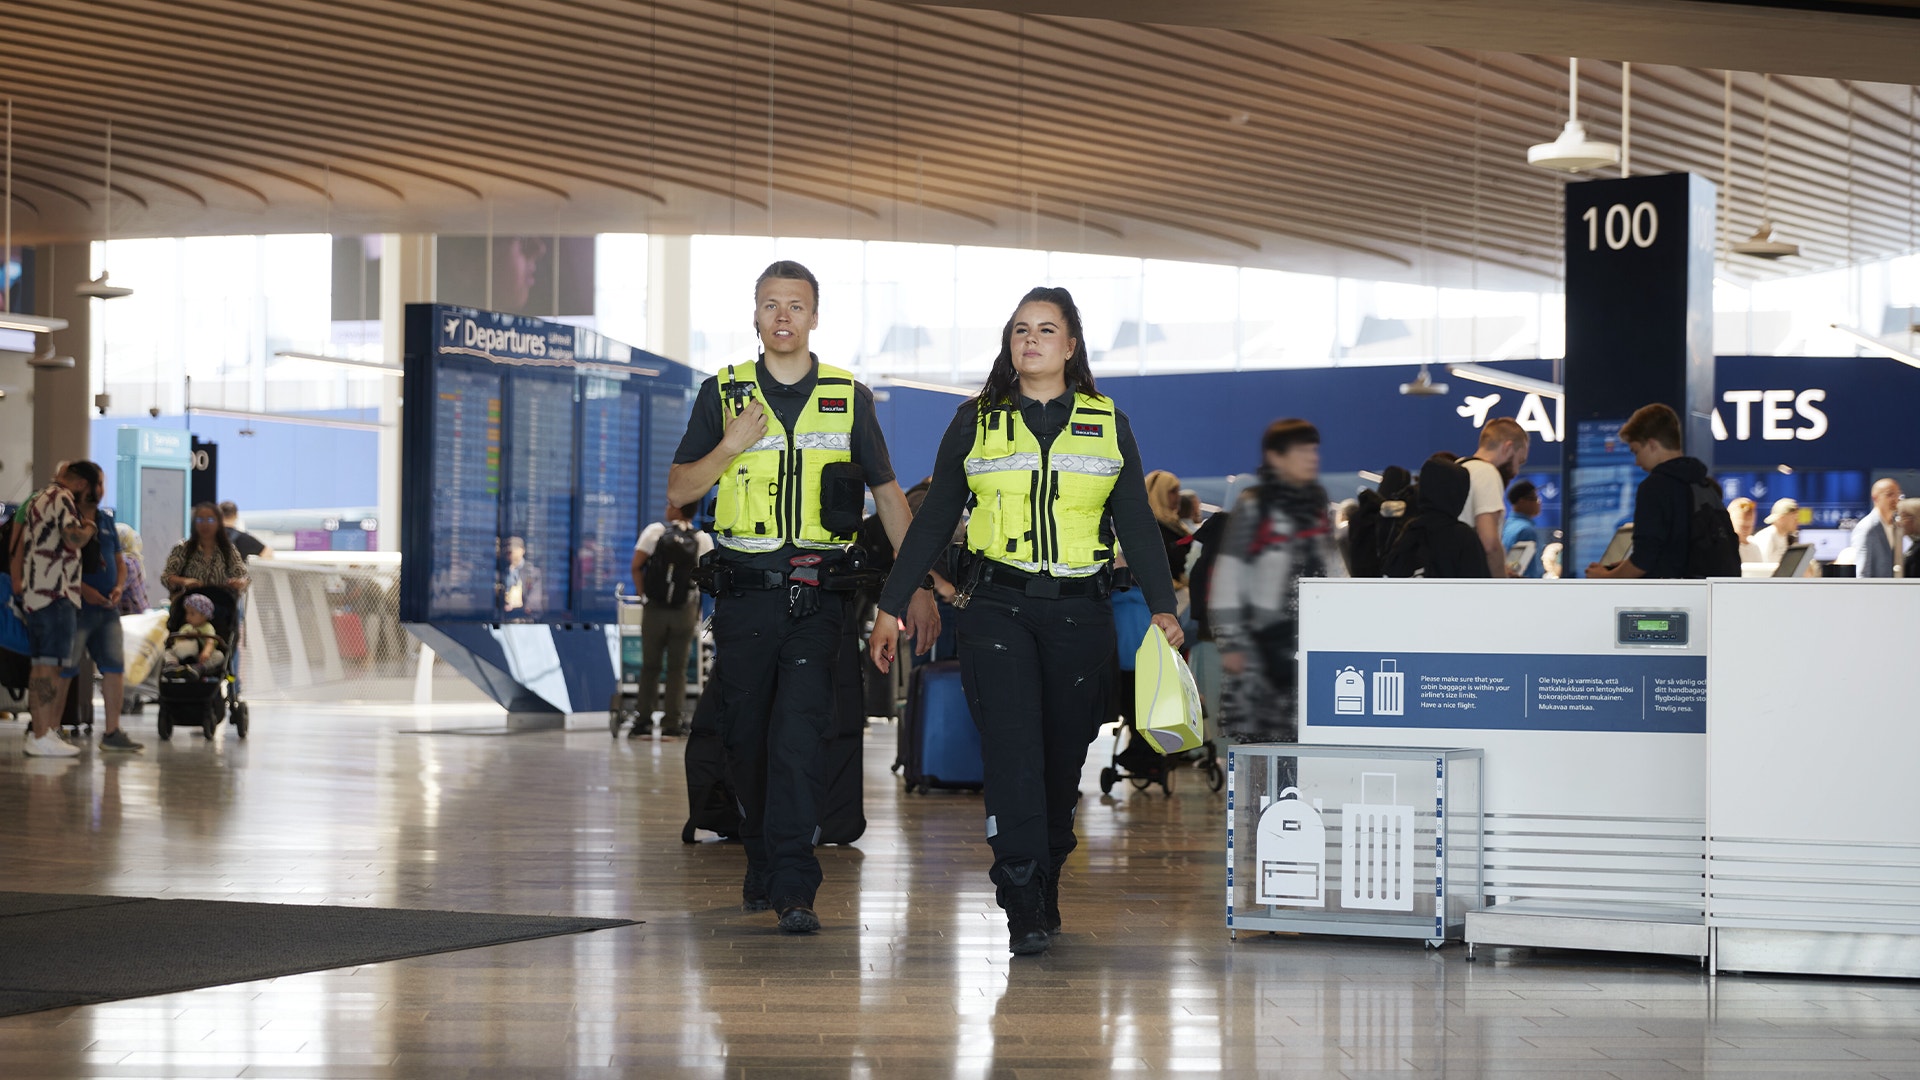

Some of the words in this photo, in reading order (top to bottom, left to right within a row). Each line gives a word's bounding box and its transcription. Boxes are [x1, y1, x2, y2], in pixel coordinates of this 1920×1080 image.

[1582, 201, 1659, 251] 100
[464, 319, 546, 356] Departures
[1596, 686, 1634, 694] lentoyhtiösi
[1538, 693, 1588, 701] kokorajoitusten
[1655, 694, 1694, 702] flygbolagets
[1458, 702, 1476, 710] flight.
[1654, 705, 1676, 713] Trevlig
